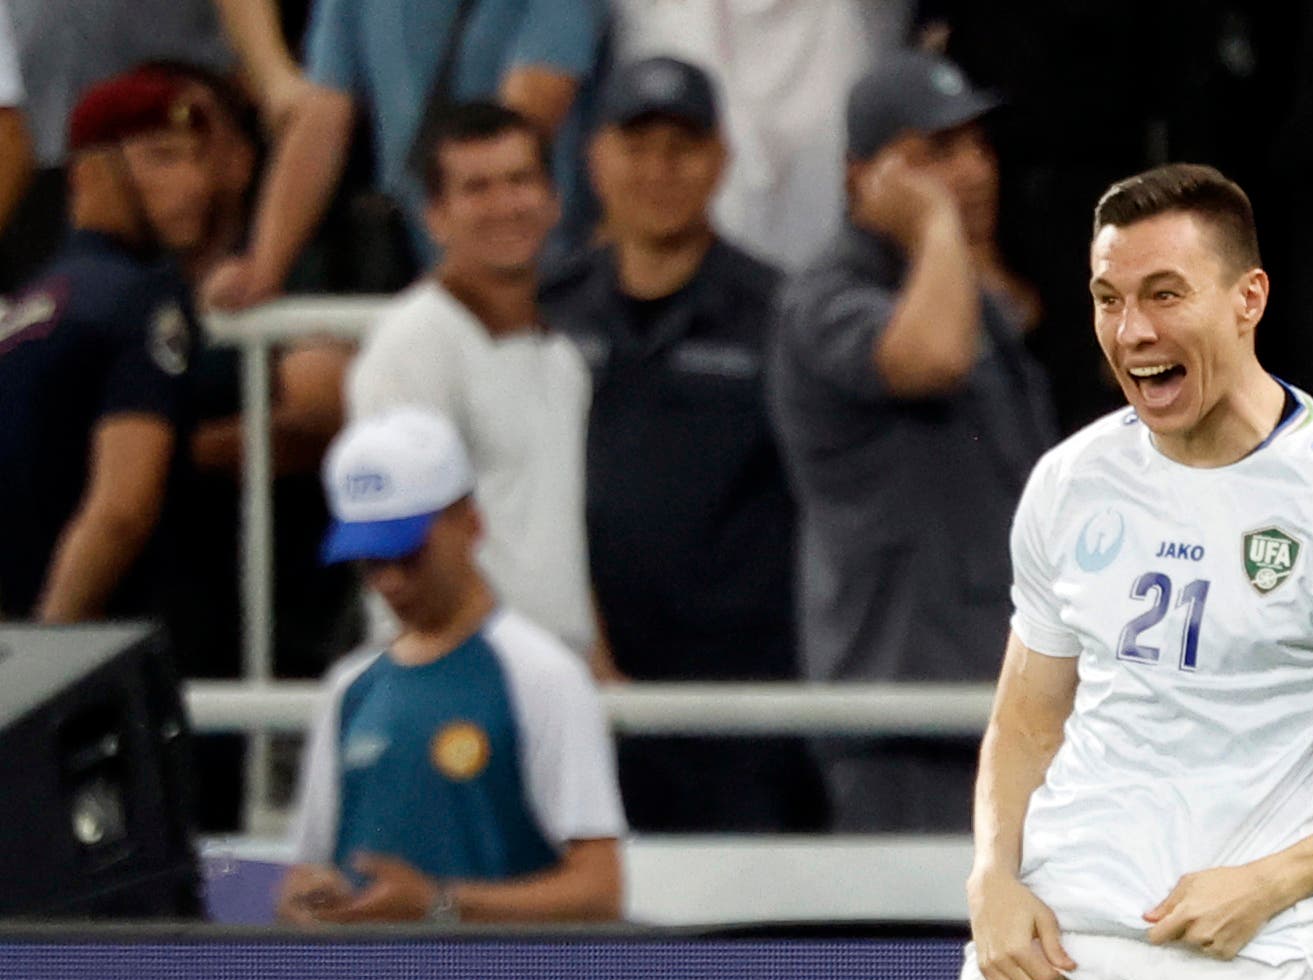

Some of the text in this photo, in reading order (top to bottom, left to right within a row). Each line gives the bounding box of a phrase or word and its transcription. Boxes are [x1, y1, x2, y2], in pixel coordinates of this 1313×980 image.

[1155, 541, 1206, 562] JAKO
[1250, 537, 1291, 568] UFA
[1116, 571, 1211, 673] 21
